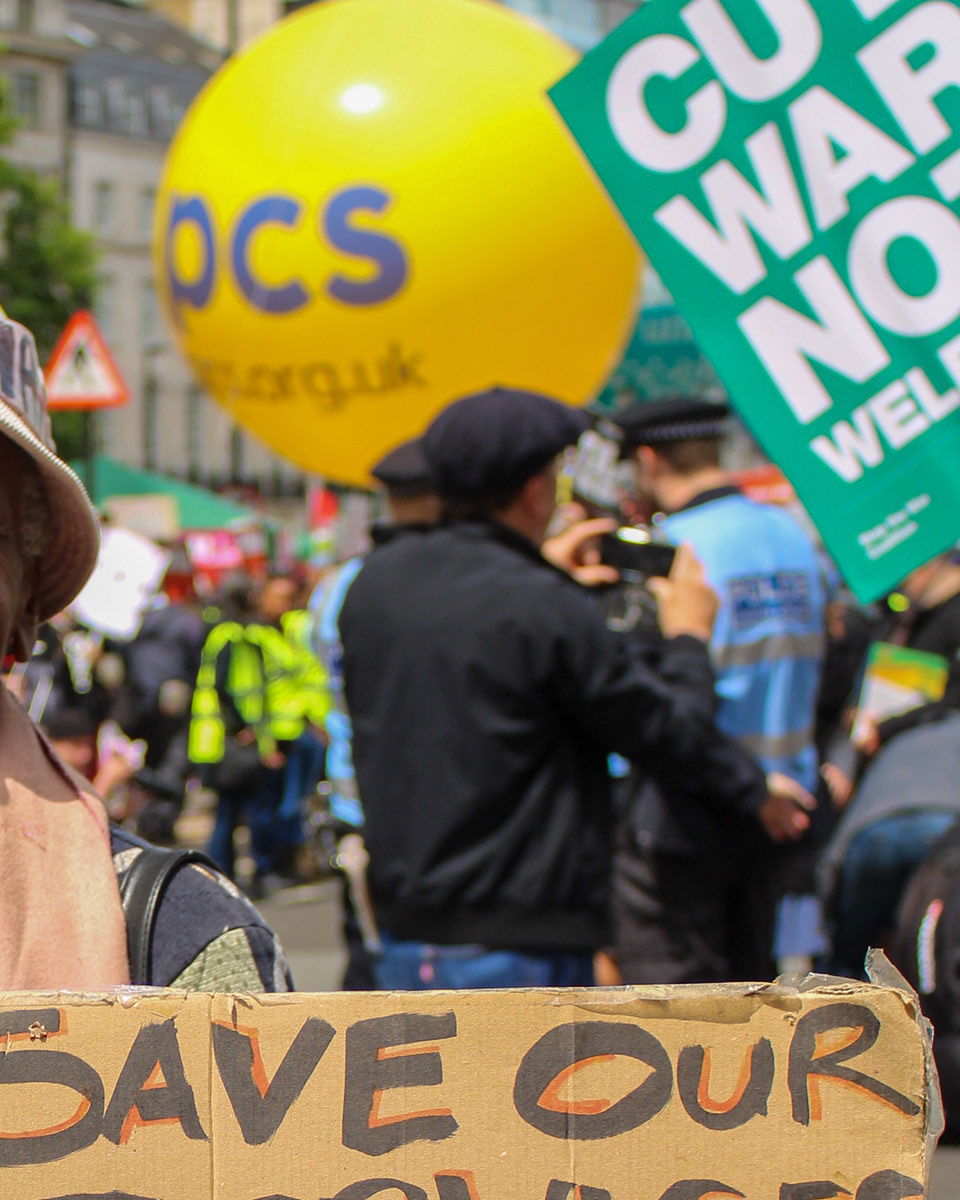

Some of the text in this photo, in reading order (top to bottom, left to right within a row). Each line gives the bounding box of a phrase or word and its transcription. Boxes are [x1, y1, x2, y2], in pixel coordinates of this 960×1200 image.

[607, 0, 902, 172] CU
[738, 150, 960, 424] NO
[513, 1002, 922, 1140] OUR
